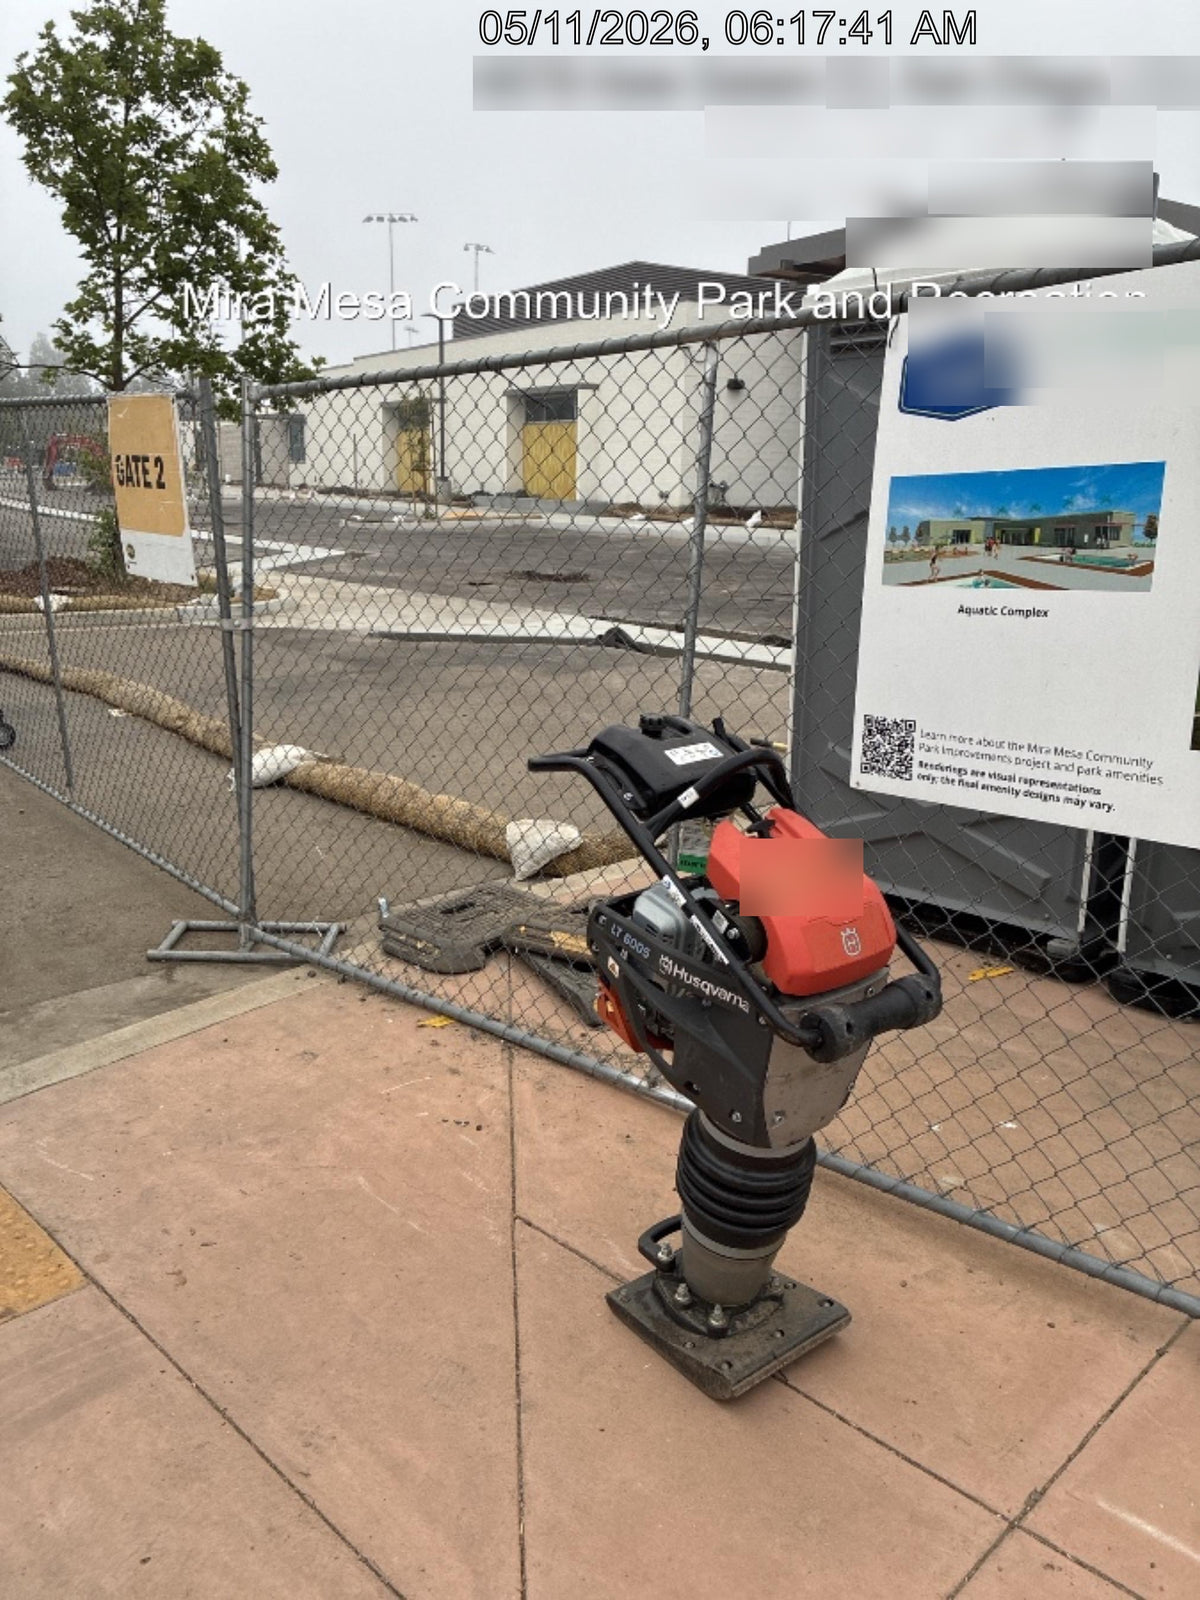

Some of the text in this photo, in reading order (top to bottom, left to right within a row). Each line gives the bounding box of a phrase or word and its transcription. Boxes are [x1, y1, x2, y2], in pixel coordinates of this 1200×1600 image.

[116, 455, 166, 490] GATE 2
[957, 604, 1049, 619] Aquatic Complex
[919, 743, 1164, 785] Park Improvements project and park amenities
[920, 729, 1153, 770] Learn more about the Mira Mesa Community
[918, 760, 1102, 795] Renderings are visual representations
[940, 775, 956, 786] the
[957, 778, 979, 789] final
[981, 782, 1021, 798] amenity
[1022, 789, 1061, 803] designs
[1063, 795, 1087, 809] may
[1089, 800, 1116, 813] vary.
[610, 923, 623, 938] LT
[672, 962, 750, 1014] Husqvarna
